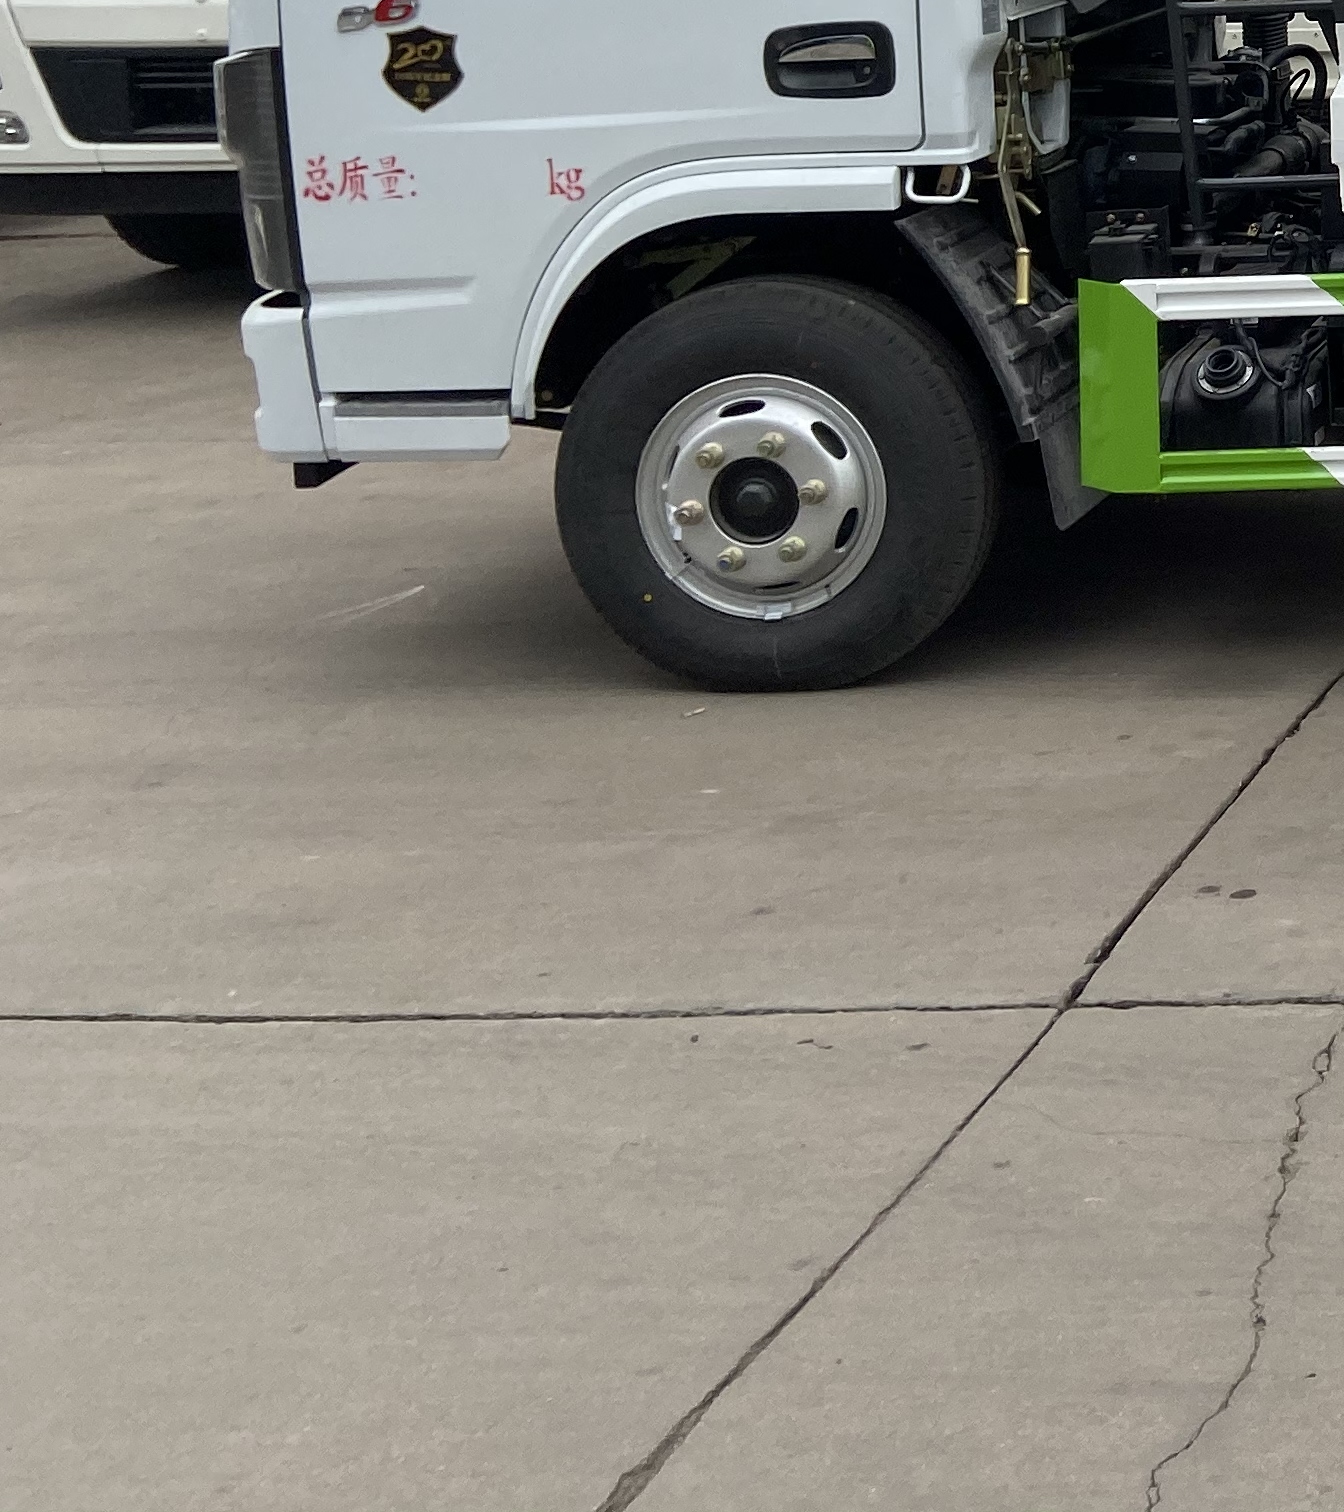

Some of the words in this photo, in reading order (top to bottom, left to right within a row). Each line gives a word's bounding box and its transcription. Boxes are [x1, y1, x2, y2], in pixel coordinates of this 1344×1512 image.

[303, 155, 417, 202] 总质量:
[546, 158, 586, 201] kg
